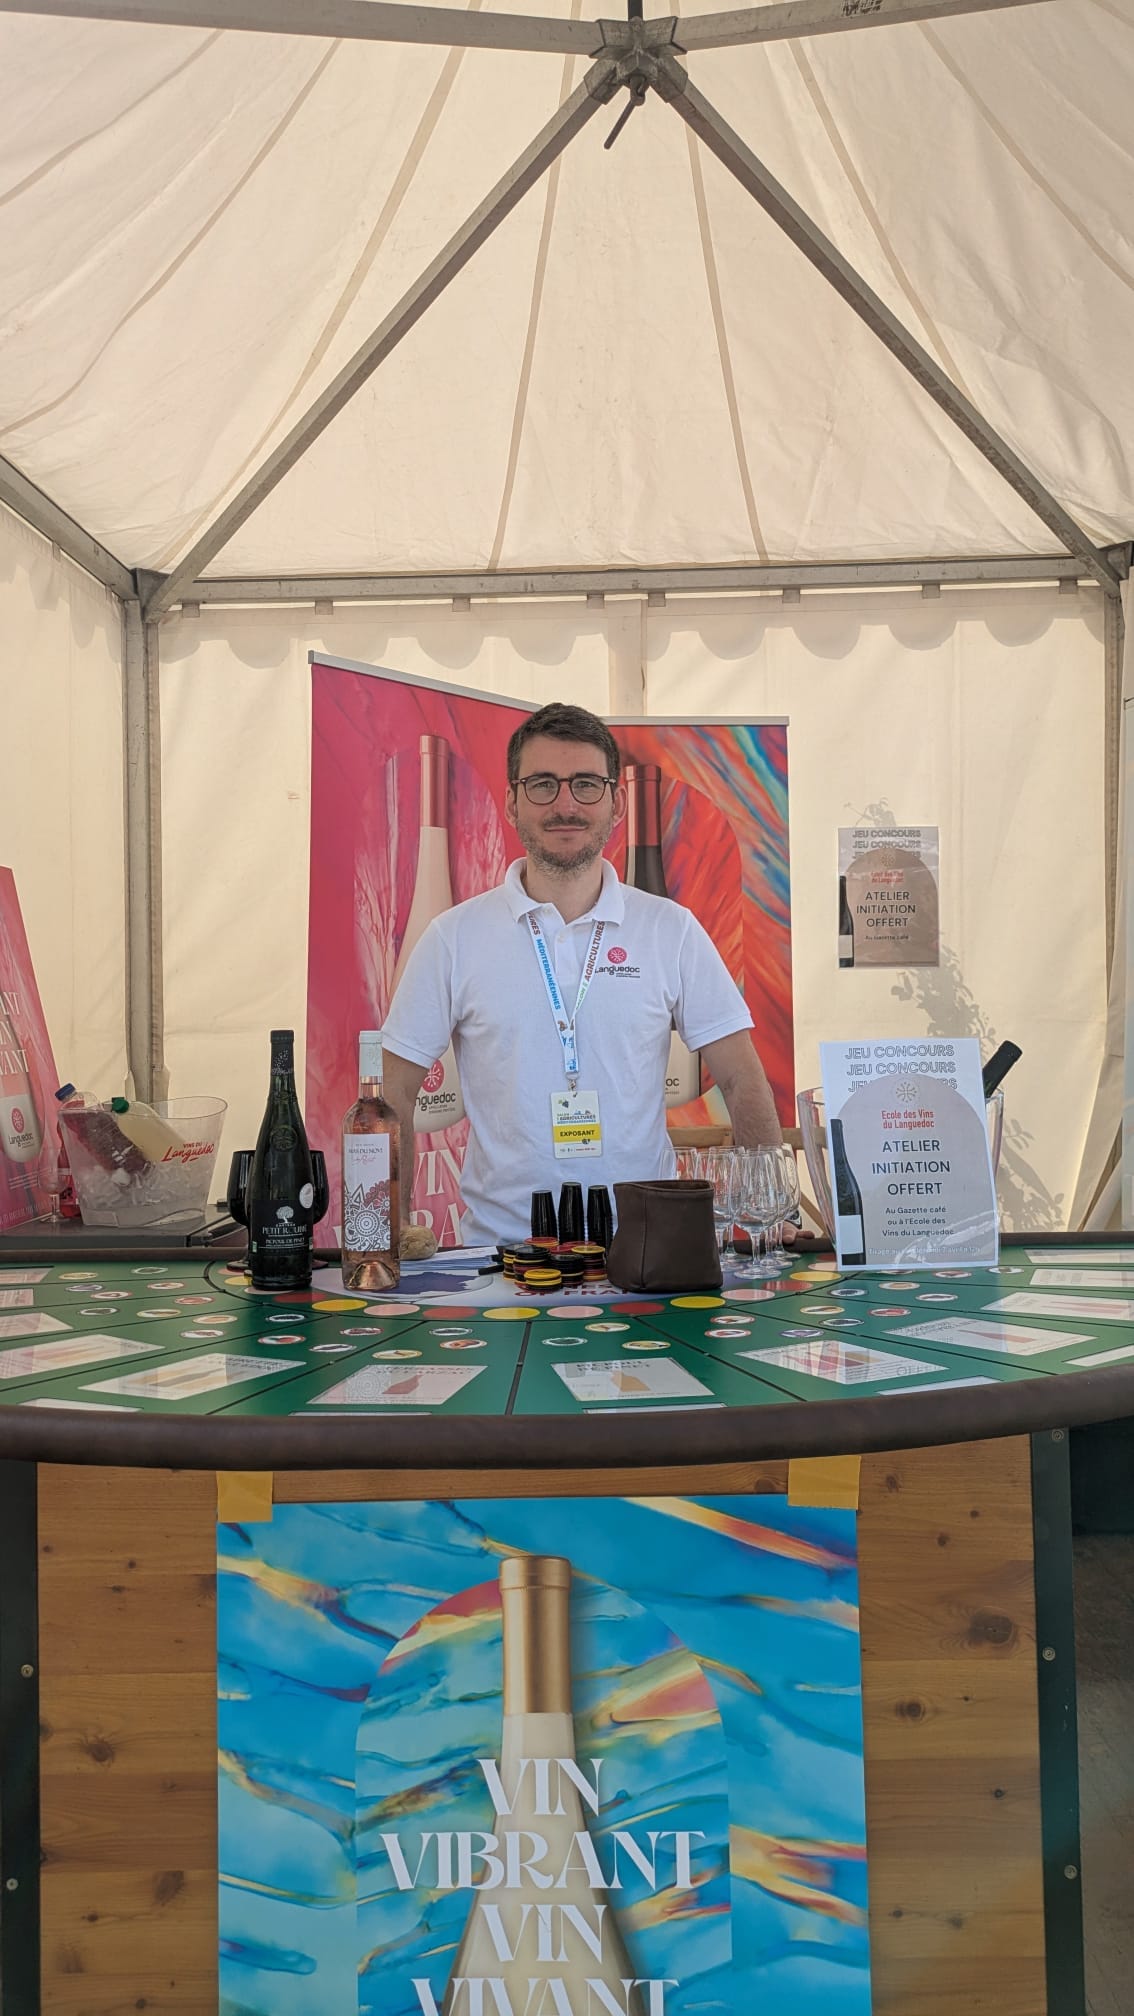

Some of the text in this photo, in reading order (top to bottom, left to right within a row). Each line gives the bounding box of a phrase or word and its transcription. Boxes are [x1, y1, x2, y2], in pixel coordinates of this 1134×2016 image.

[852, 829, 921, 838] JEU CONCOURS
[871, 840, 921, 848] CONCOURS
[866, 891, 910, 901] ATELIER
[857, 904, 916, 914] INITIATION
[866, 917, 909, 927] OFFERT
[584, 920, 606, 982] AGRICULTURES
[845, 1045, 955, 1059] JEU CONCOURS
[847, 1061, 957, 1076] JEU CONCOURS
[881, 1108, 934, 1119] Ecole des Vins
[883, 1117, 935, 1130] du Languedoc
[560, 1129, 595, 1137] EXPOSANT
[882, 1139, 941, 1153] ATELIER
[872, 1160, 951, 1174] INITIATION
[887, 1182, 943, 1195] OFFERT
[898, 1206, 929, 1214] Gazette
[929, 1205, 947, 1214] café
[887, 1218, 898, 1226] ou
[898, 1217, 904, 1225] à
[931, 1216, 946, 1225] des
[882, 1228, 955, 1239] Vins du Languedoc
[477, 1758, 604, 1816] VIN
[380, 1831, 706, 1890] VIBRANT
[480, 1904, 608, 1964] VIN
[412, 1979, 680, 2016] VIVANT
